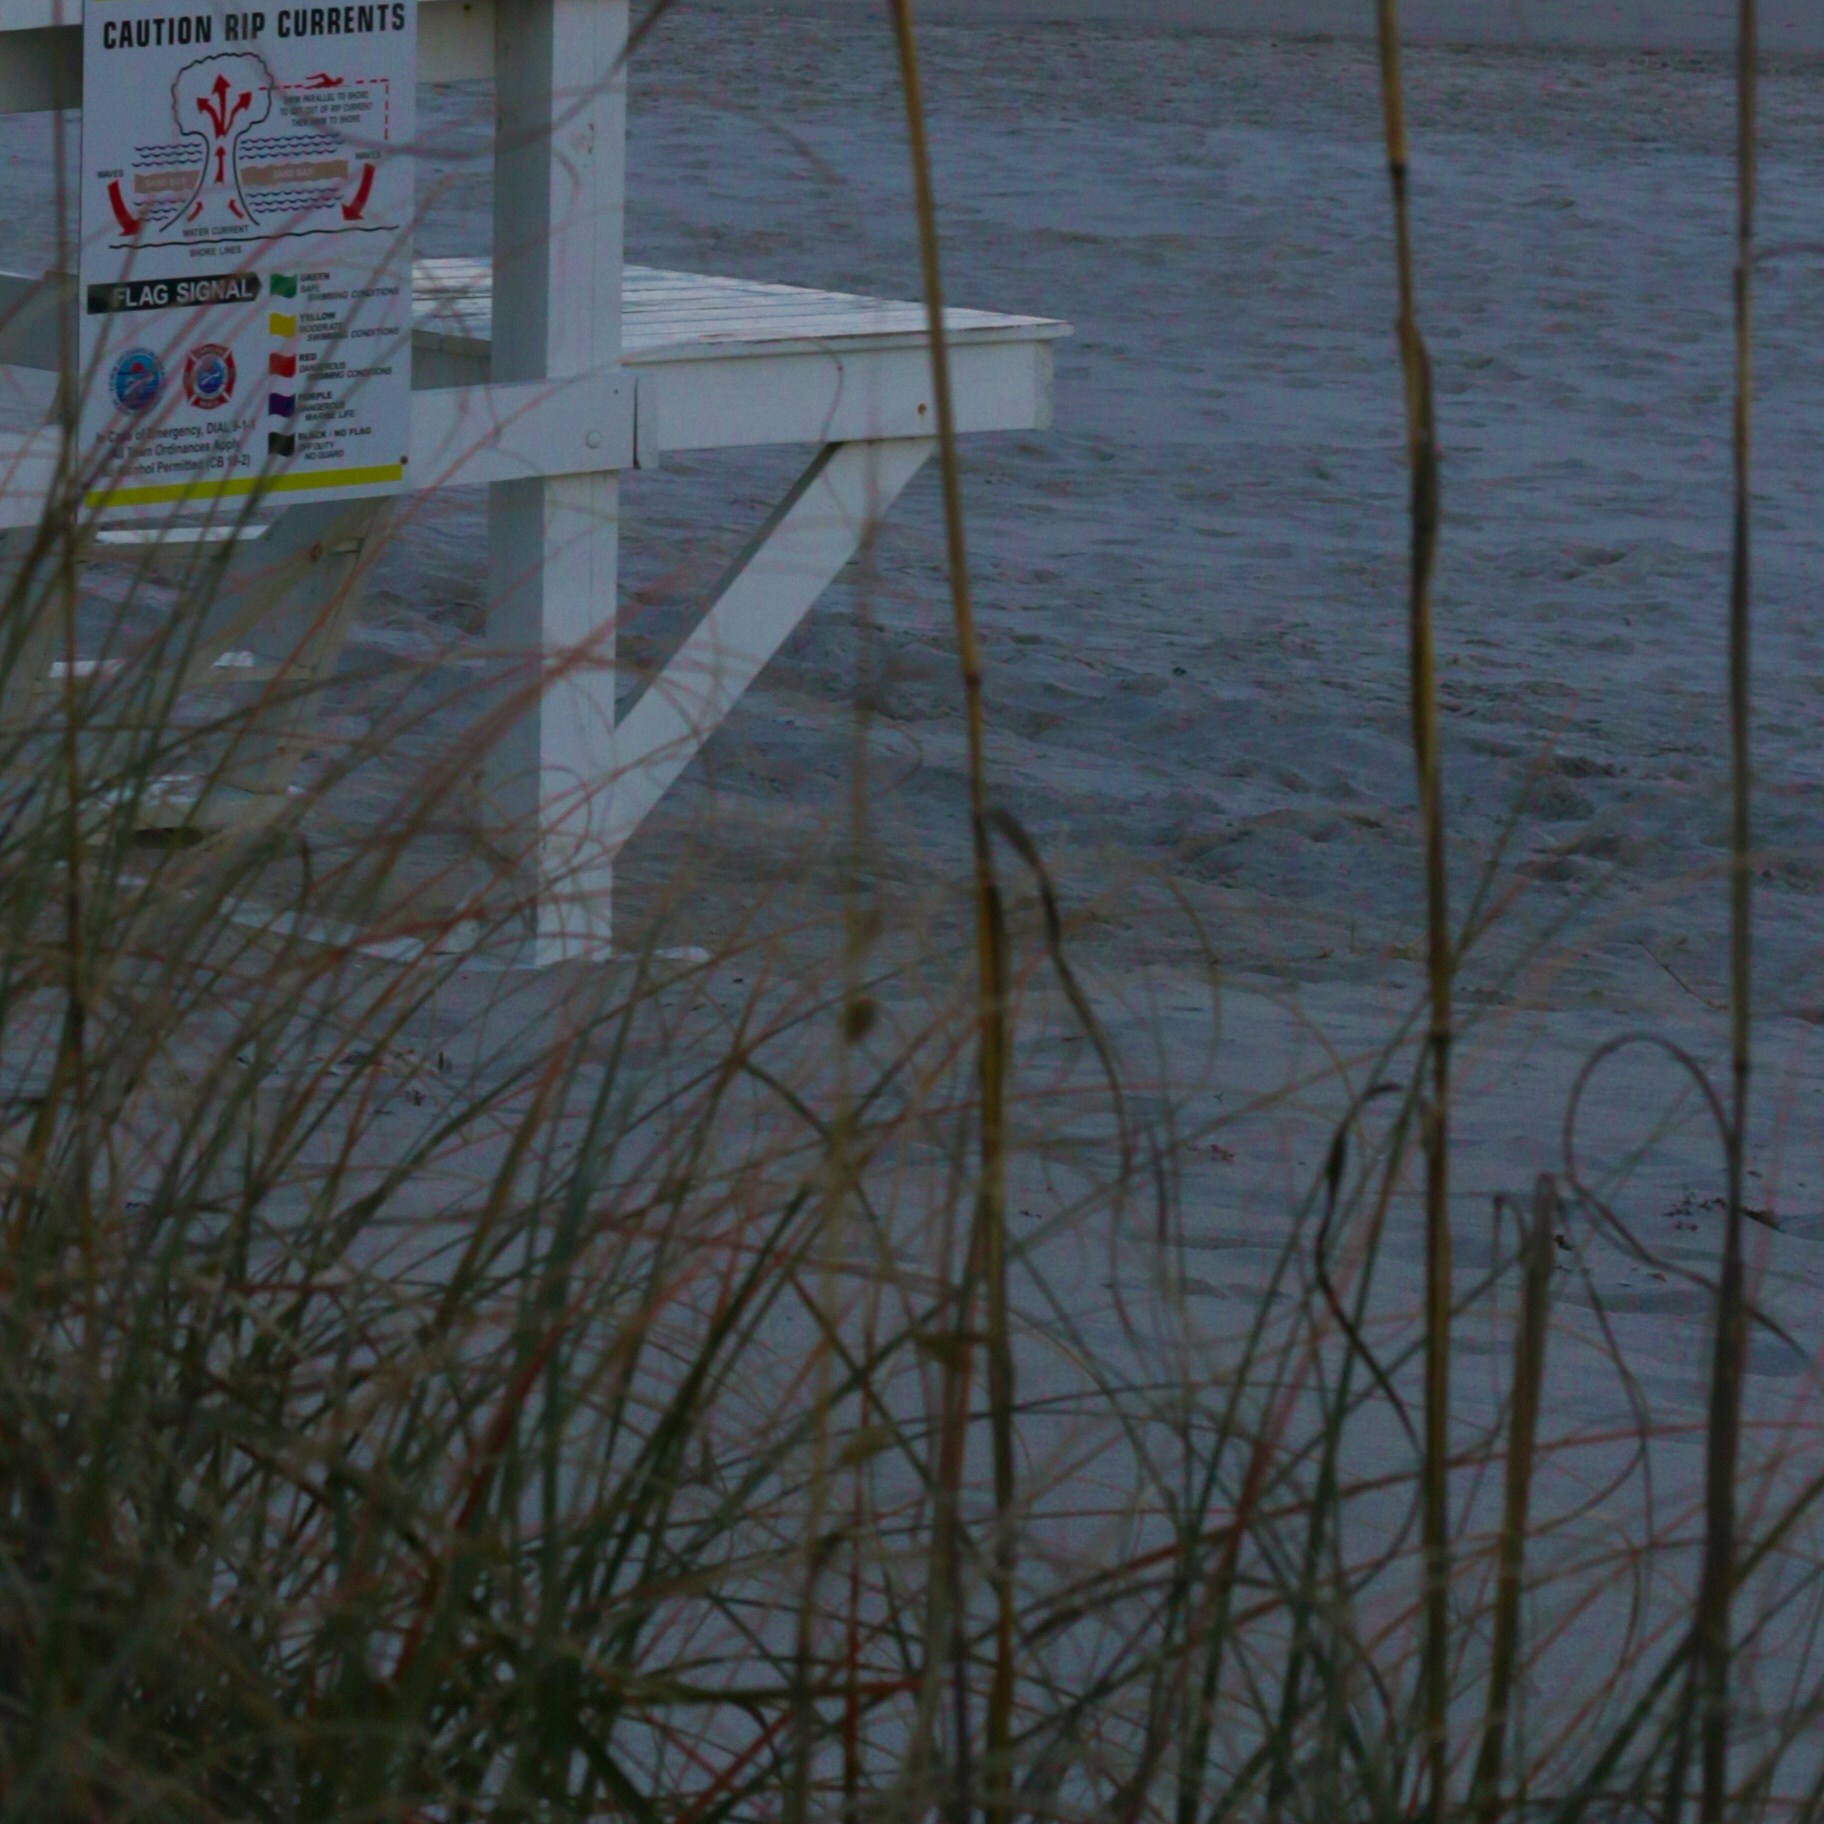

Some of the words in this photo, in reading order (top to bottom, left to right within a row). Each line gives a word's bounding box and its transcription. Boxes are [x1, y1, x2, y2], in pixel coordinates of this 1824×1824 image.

[103, 15, 212, 49] CAUTION
[224, 12, 266, 41] RIP
[277, 3, 405, 38] CURRENTS
[183, 226, 209, 237] WATER
[212, 224, 249, 235] CURRENT
[189, 247, 216, 257] SHORE
[219, 245, 242, 256] LINES
[111, 283, 169, 307] FLAG
[176, 278, 253, 303] SIGNAL
[299, 352, 317, 362] RED
[334, 428, 347, 437] NO
[349, 426, 371, 436] FLAG
[156, 440, 211, 456] Ordinances
